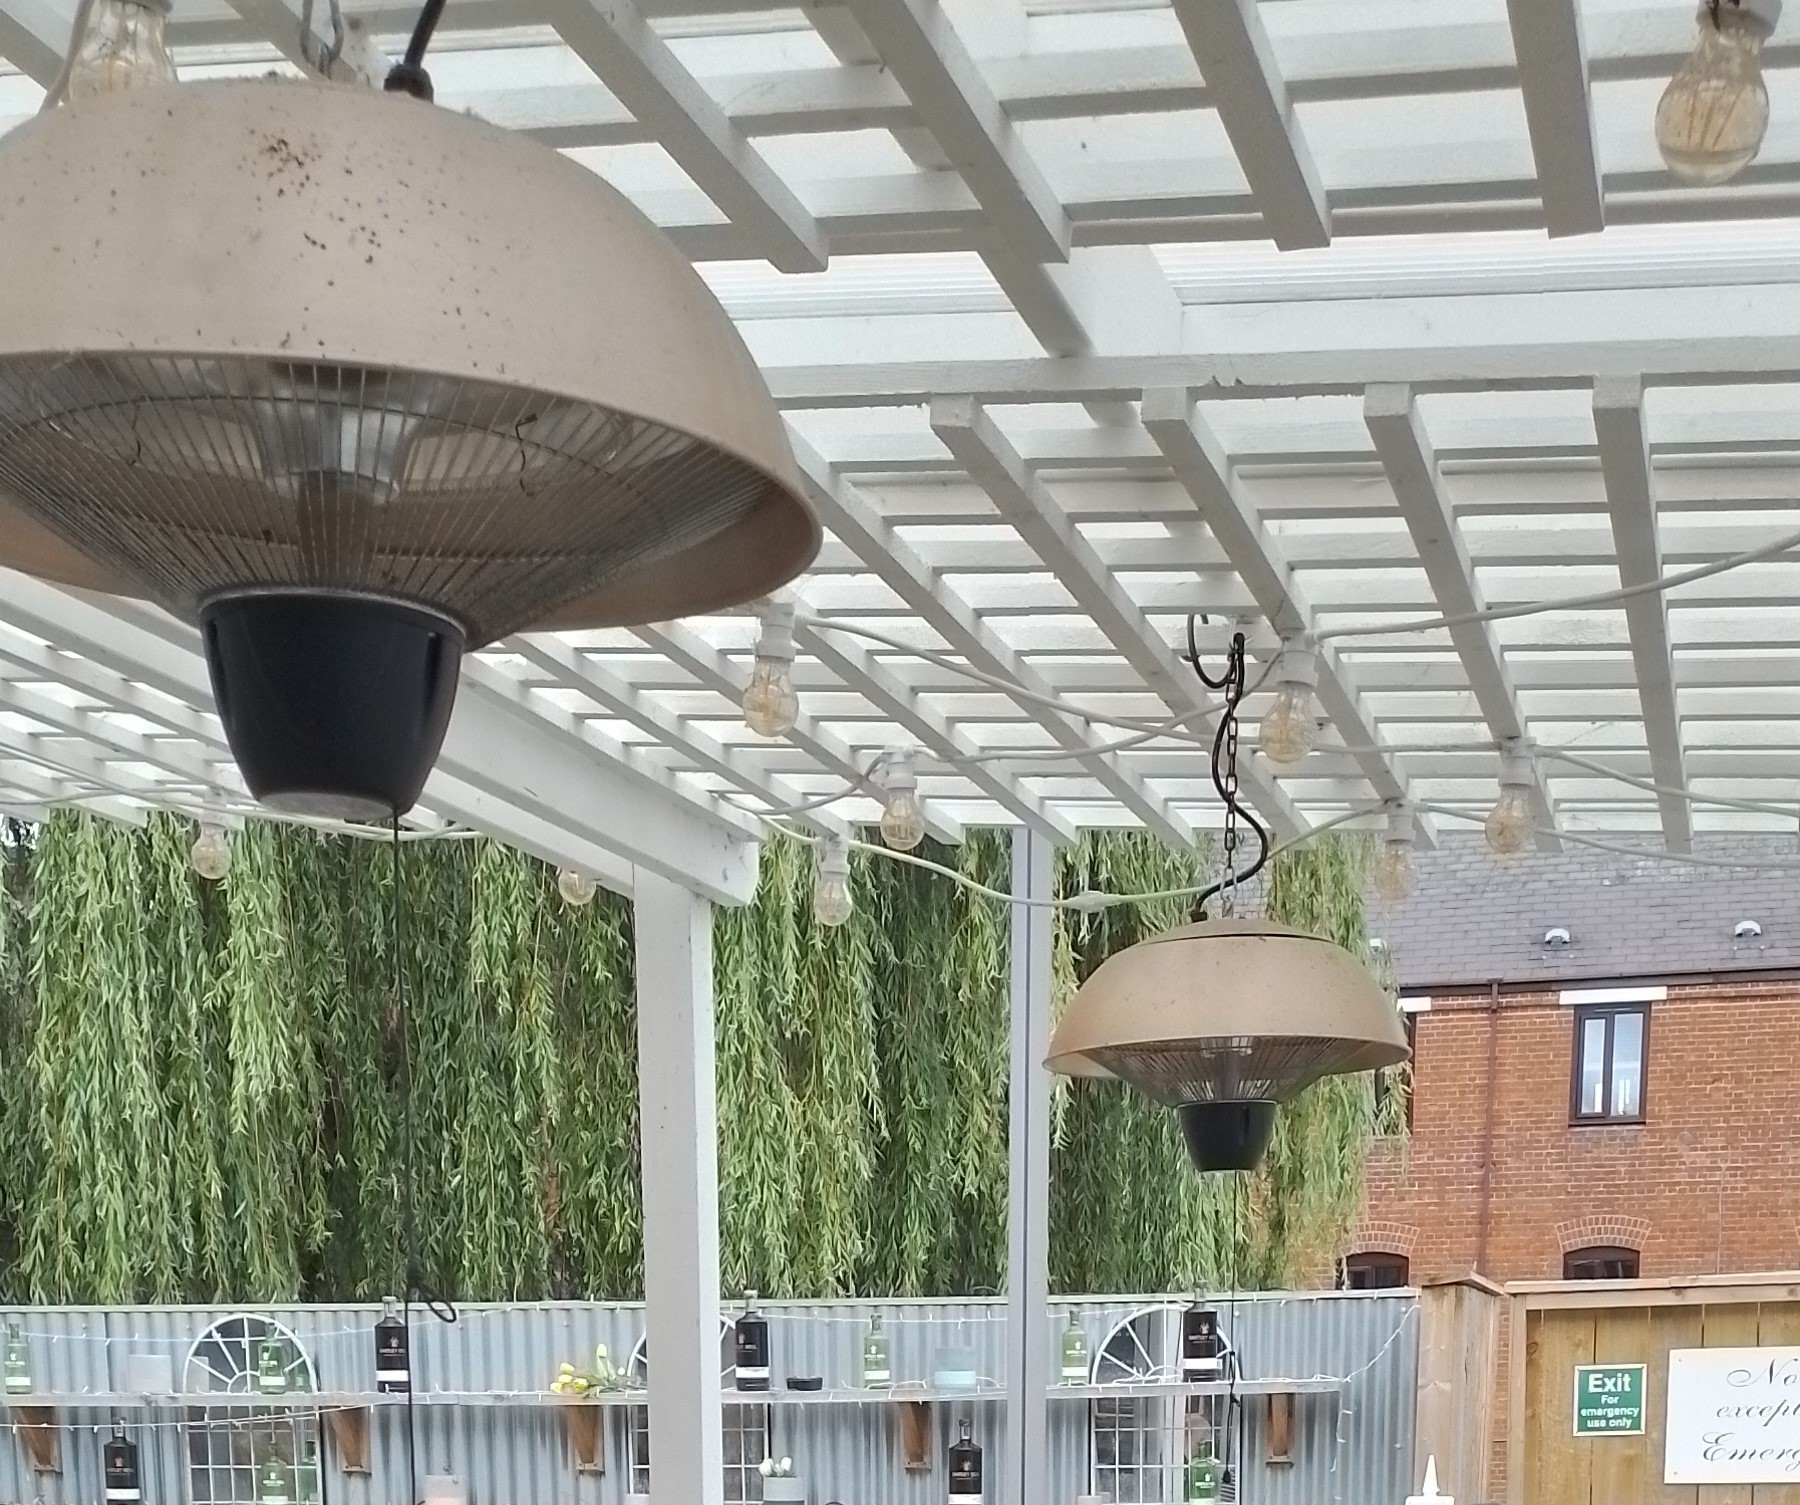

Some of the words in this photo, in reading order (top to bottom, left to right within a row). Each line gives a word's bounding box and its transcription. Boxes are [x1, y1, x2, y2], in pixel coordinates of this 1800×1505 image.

[1588, 1373, 1632, 1393] Exit
[1601, 1395, 1620, 1405] For
[1580, 1407, 1640, 1418] emergency
[1587, 1419, 1606, 1428] use
[1609, 1417, 1632, 1429] only
